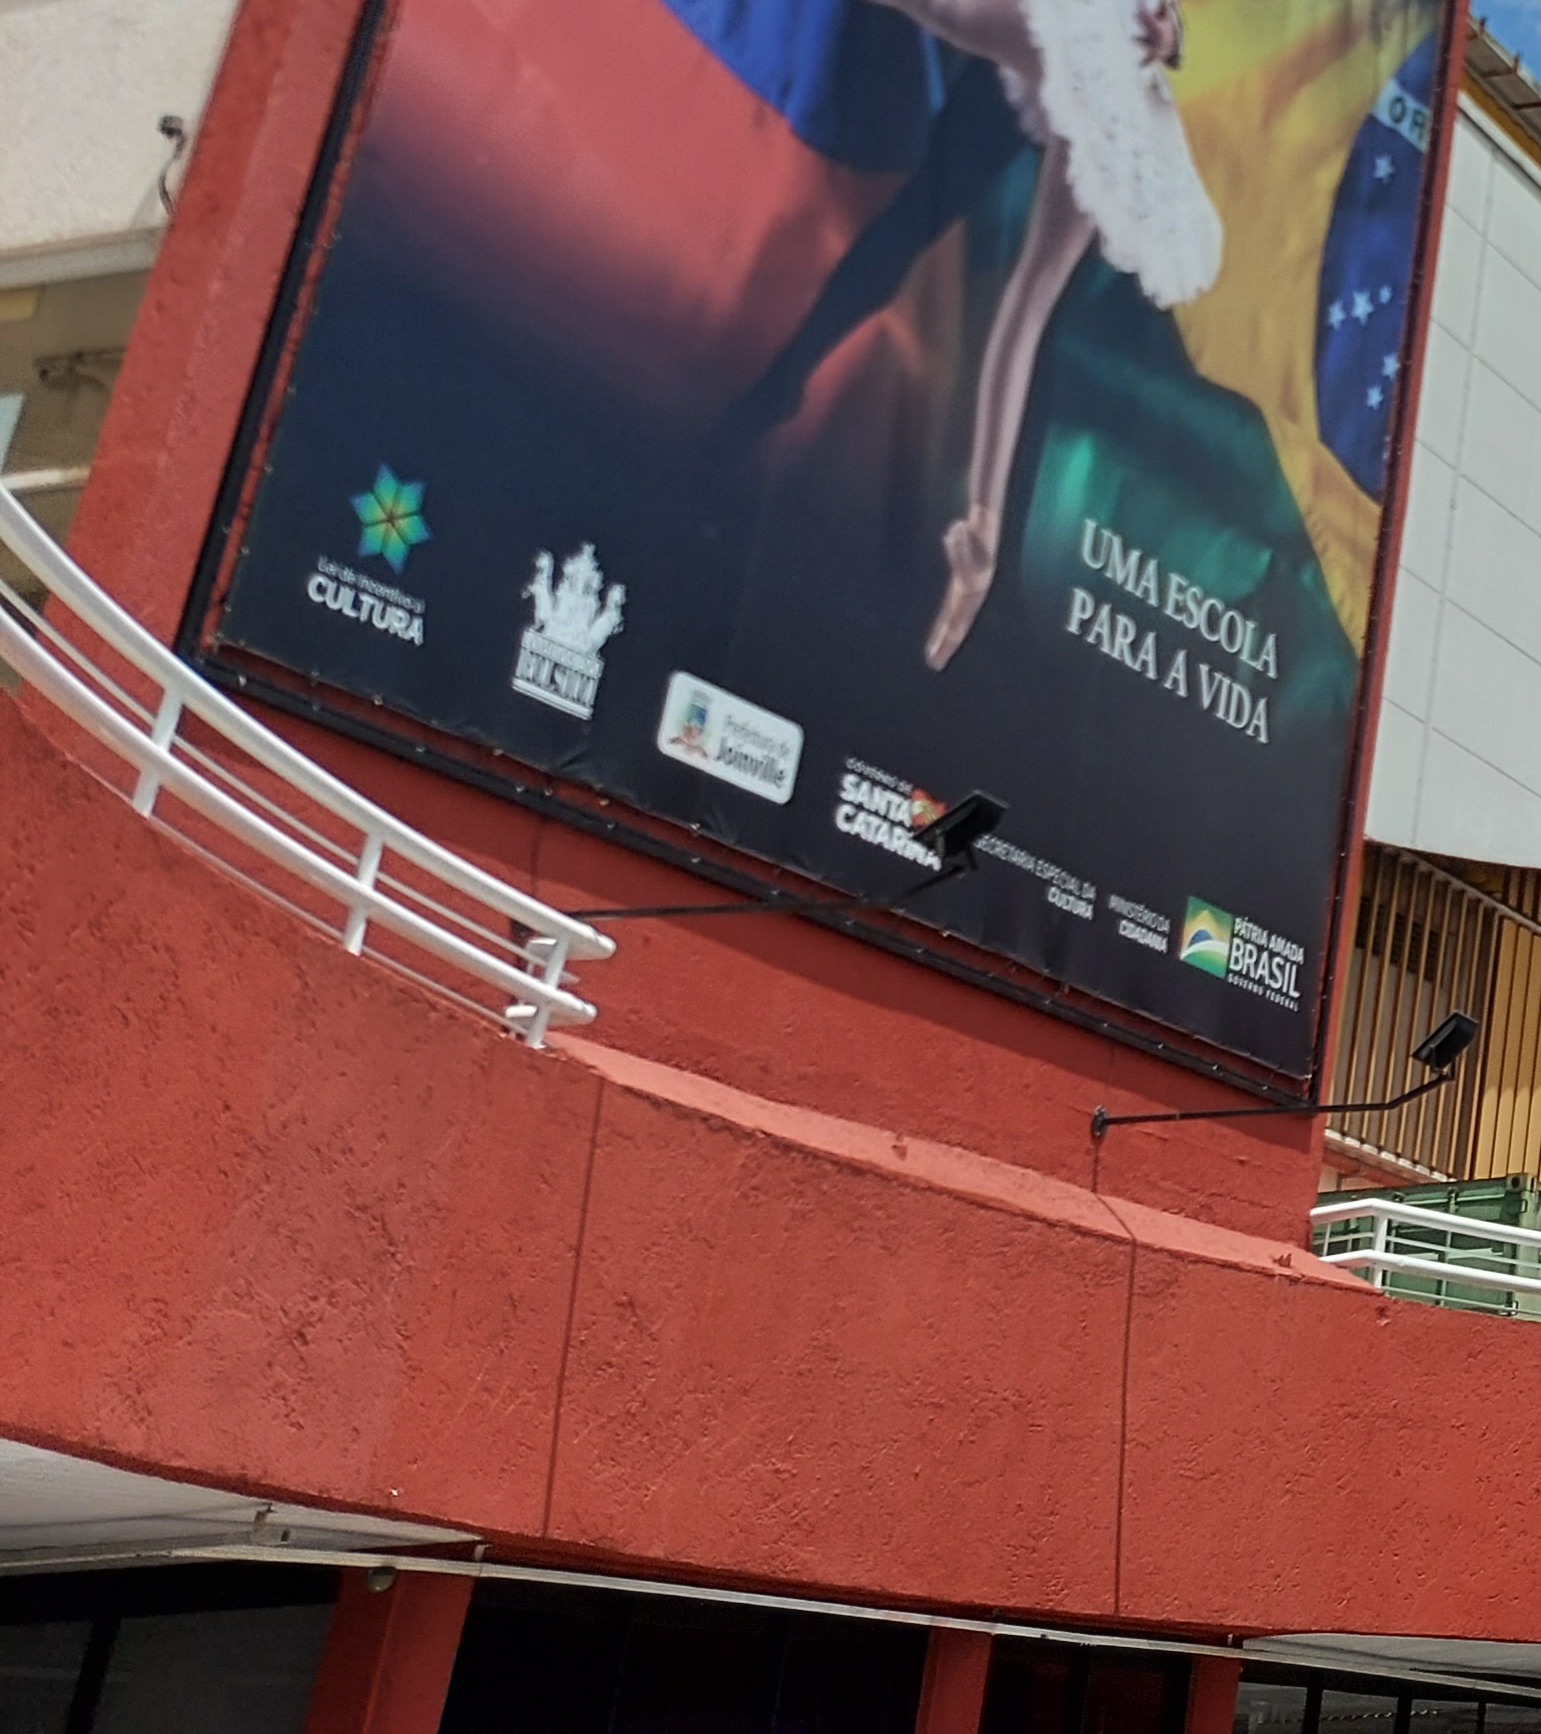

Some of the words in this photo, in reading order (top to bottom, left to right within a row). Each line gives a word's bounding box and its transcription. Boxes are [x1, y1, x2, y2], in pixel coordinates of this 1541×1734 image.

[307, 574, 424, 646] CULTURA
[1082, 518, 1159, 607] UMA
[1164, 572, 1278, 679] ESCOLA
[1067, 587, 1158, 680] PARA
[1163, 649, 1189, 698] A
[1199, 663, 1270, 744] VIDA
[840, 773, 912, 828] SANTA
[1229, 937, 1300, 998] BRASIL
[1234, 917, 1269, 948] PÁTRIA
[1268, 933, 1305, 965] AMADA
